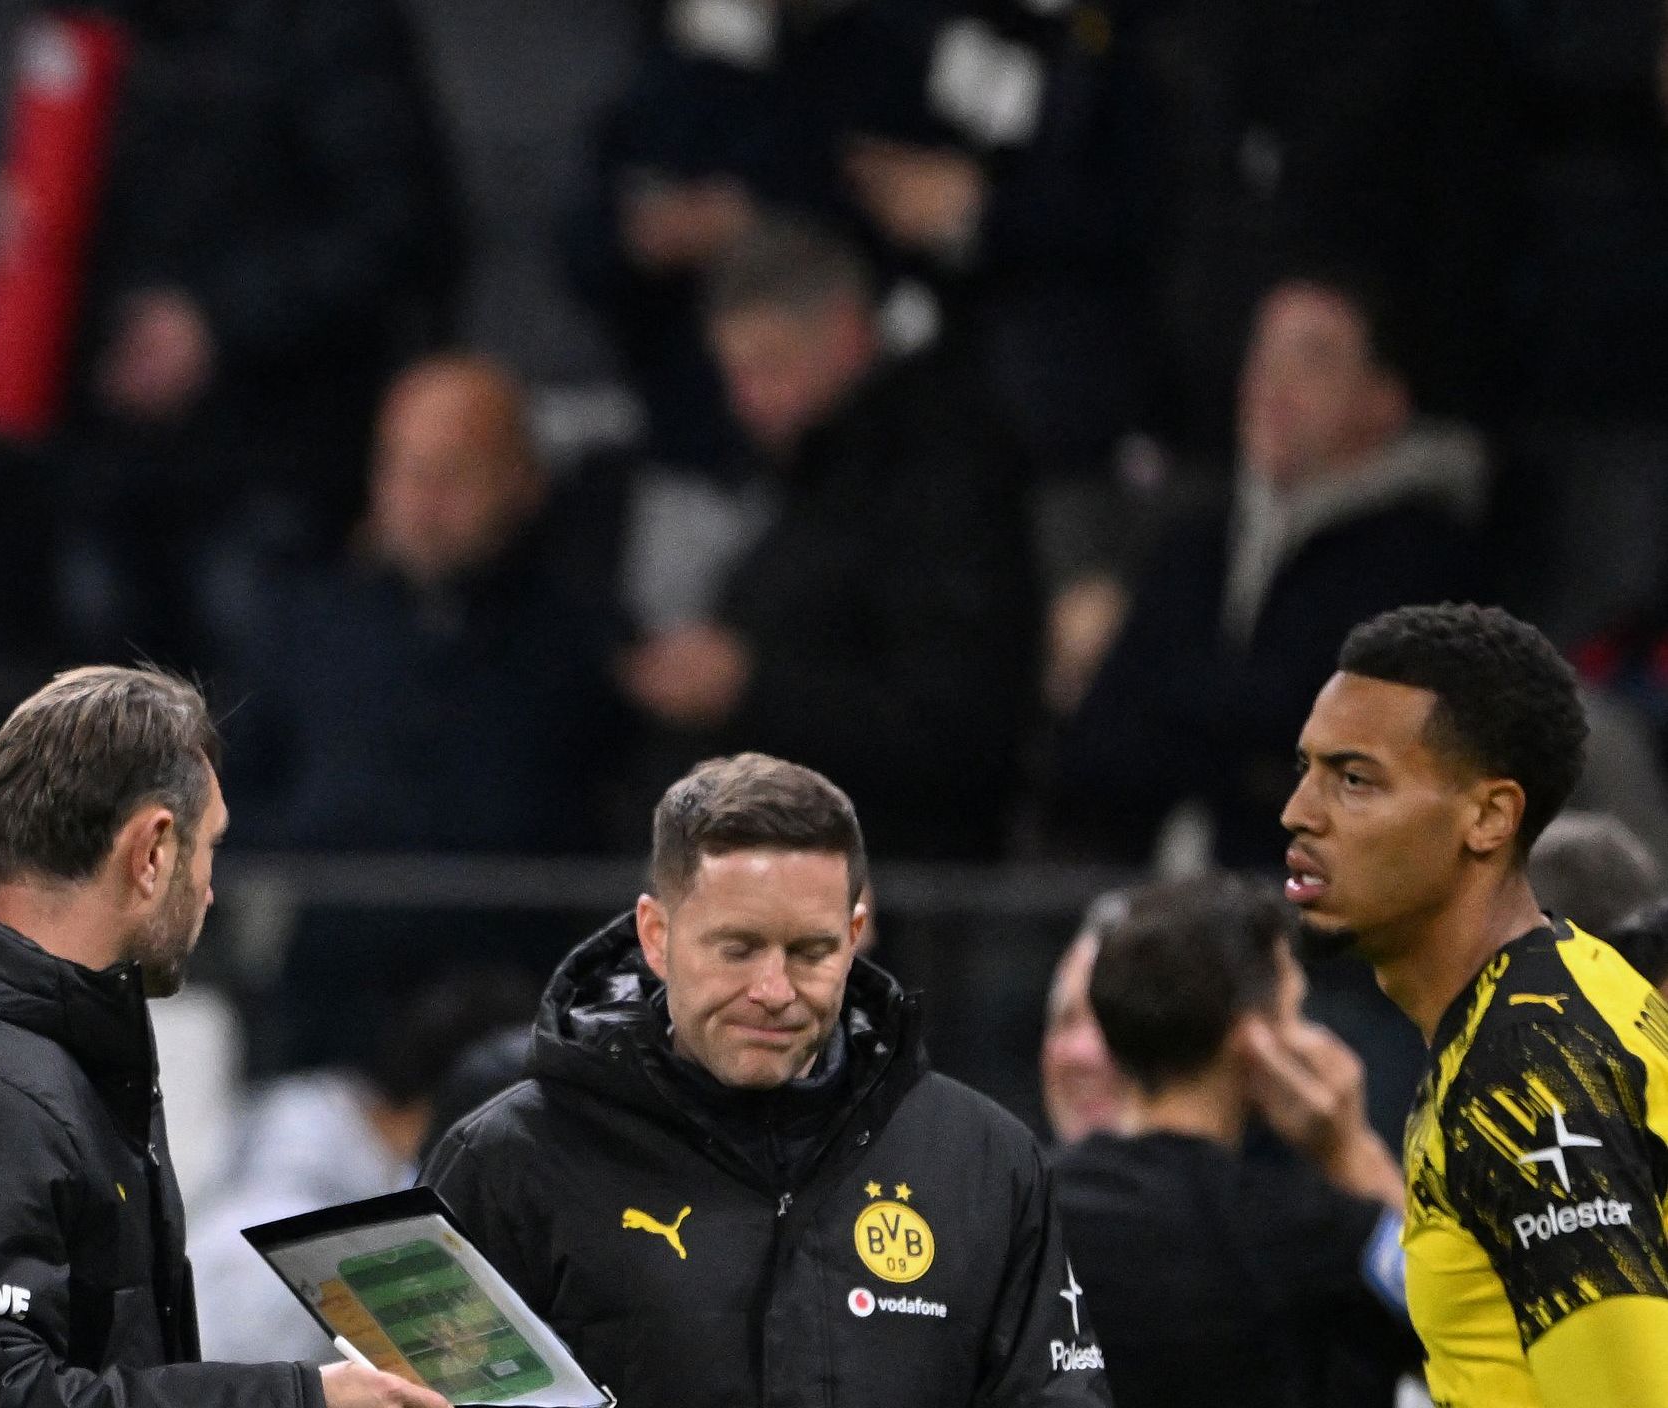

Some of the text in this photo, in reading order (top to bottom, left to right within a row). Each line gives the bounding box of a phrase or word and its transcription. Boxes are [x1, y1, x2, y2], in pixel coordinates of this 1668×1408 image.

[867, 1212, 923, 1257] BVB
[1513, 1196, 1633, 1250] Polestar
[886, 1256, 907, 1273] 09
[877, 1296, 948, 1319] vodafone
